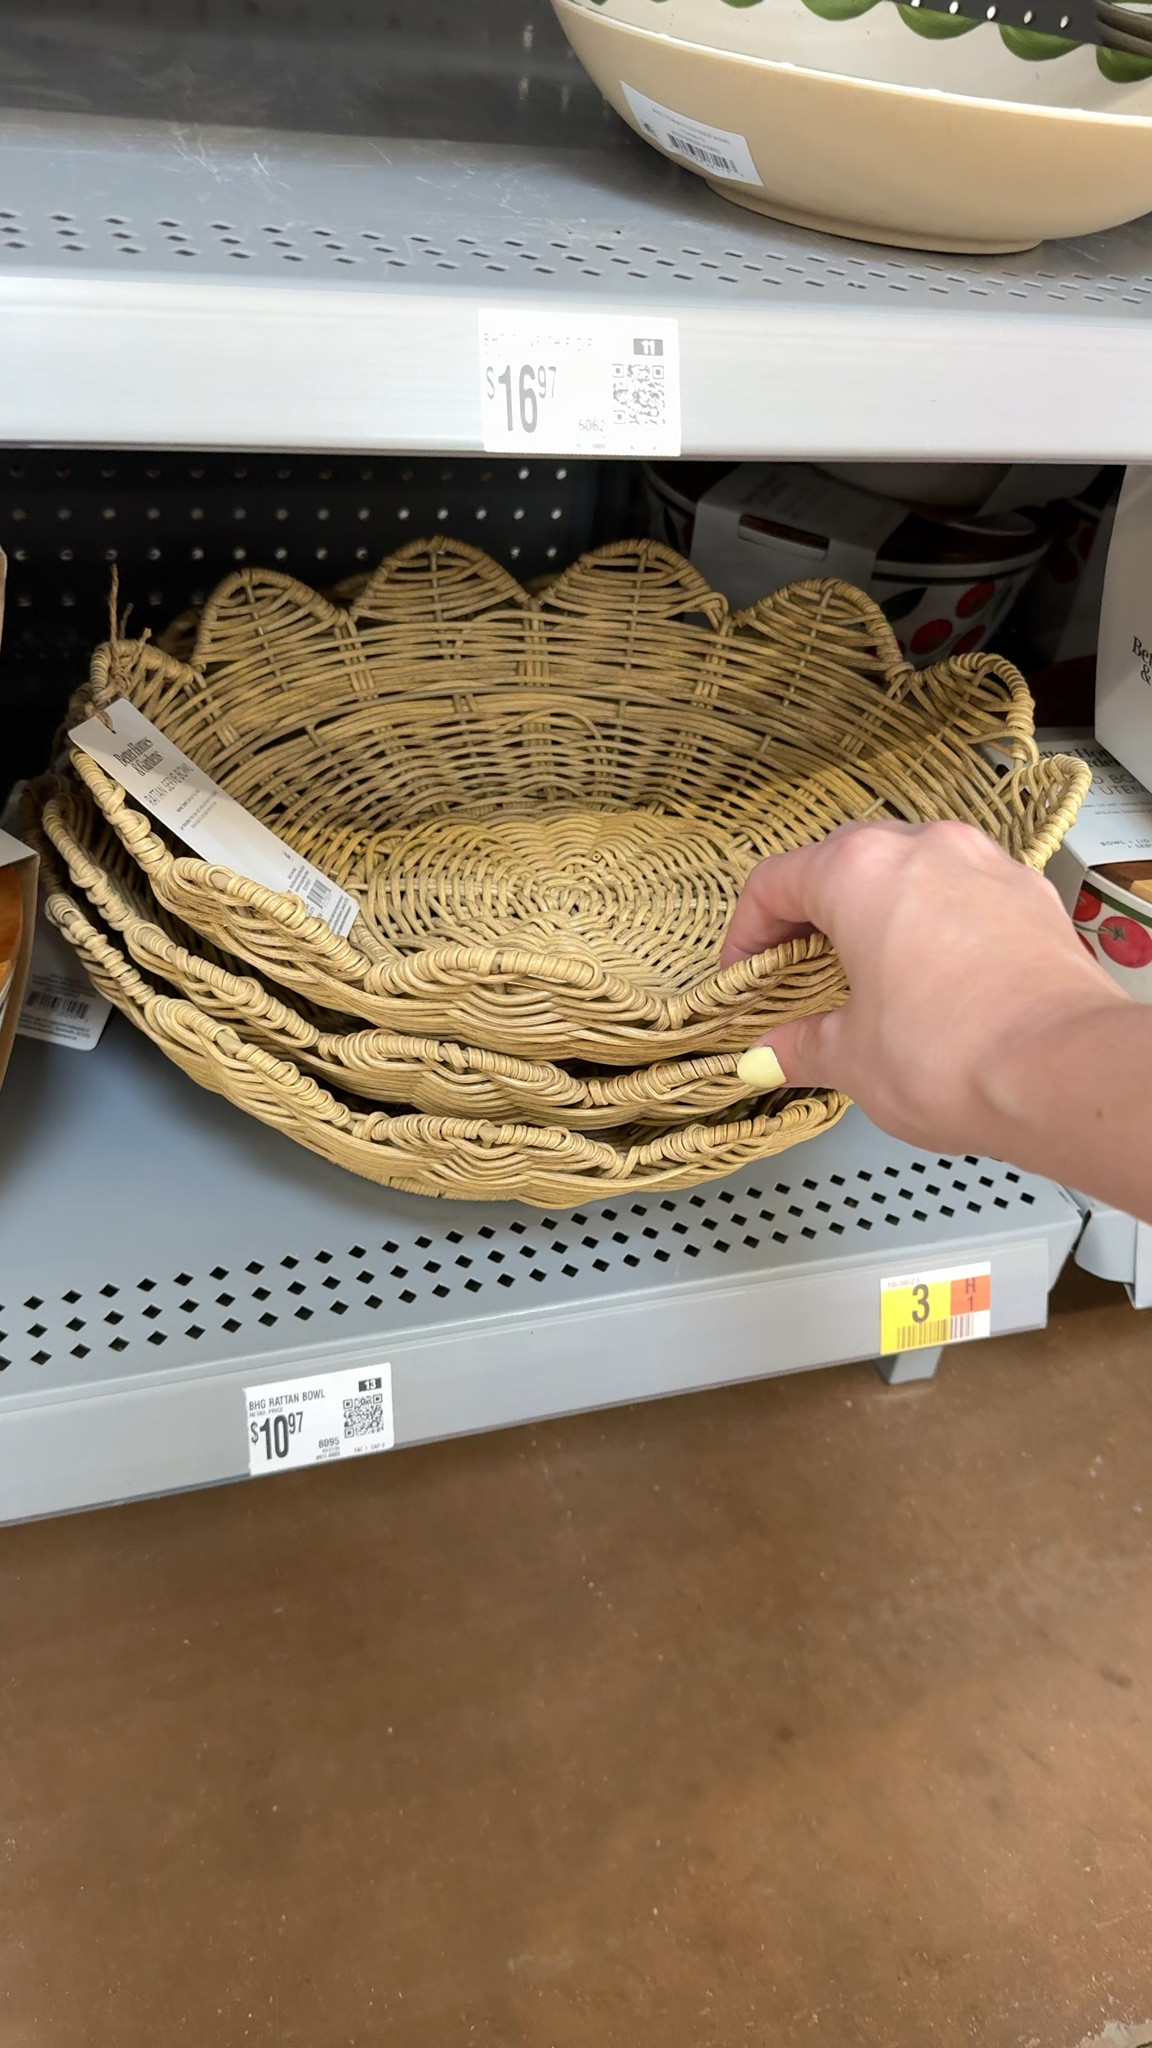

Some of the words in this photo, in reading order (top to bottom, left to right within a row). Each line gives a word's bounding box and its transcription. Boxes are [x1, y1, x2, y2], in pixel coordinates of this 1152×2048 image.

[641, 339, 656, 356] 11
[1140, 663, 1152, 687] &
[112, 748, 138, 768] Better
[127, 736, 154, 758] Homes
[135, 750, 164, 774] Gardens
[131, 761, 146, 777] &
[143, 783, 169, 807] RATTAN
[965, 1276, 977, 1295] H
[912, 1283, 931, 1324] 3
[967, 1295, 974, 1312] 1
[364, 1379, 377, 1391] 13
[248, 1398, 267, 1412] BHG
[268, 1392, 300, 1408] RATTAN
[302, 1388, 326, 1402] BOWL
